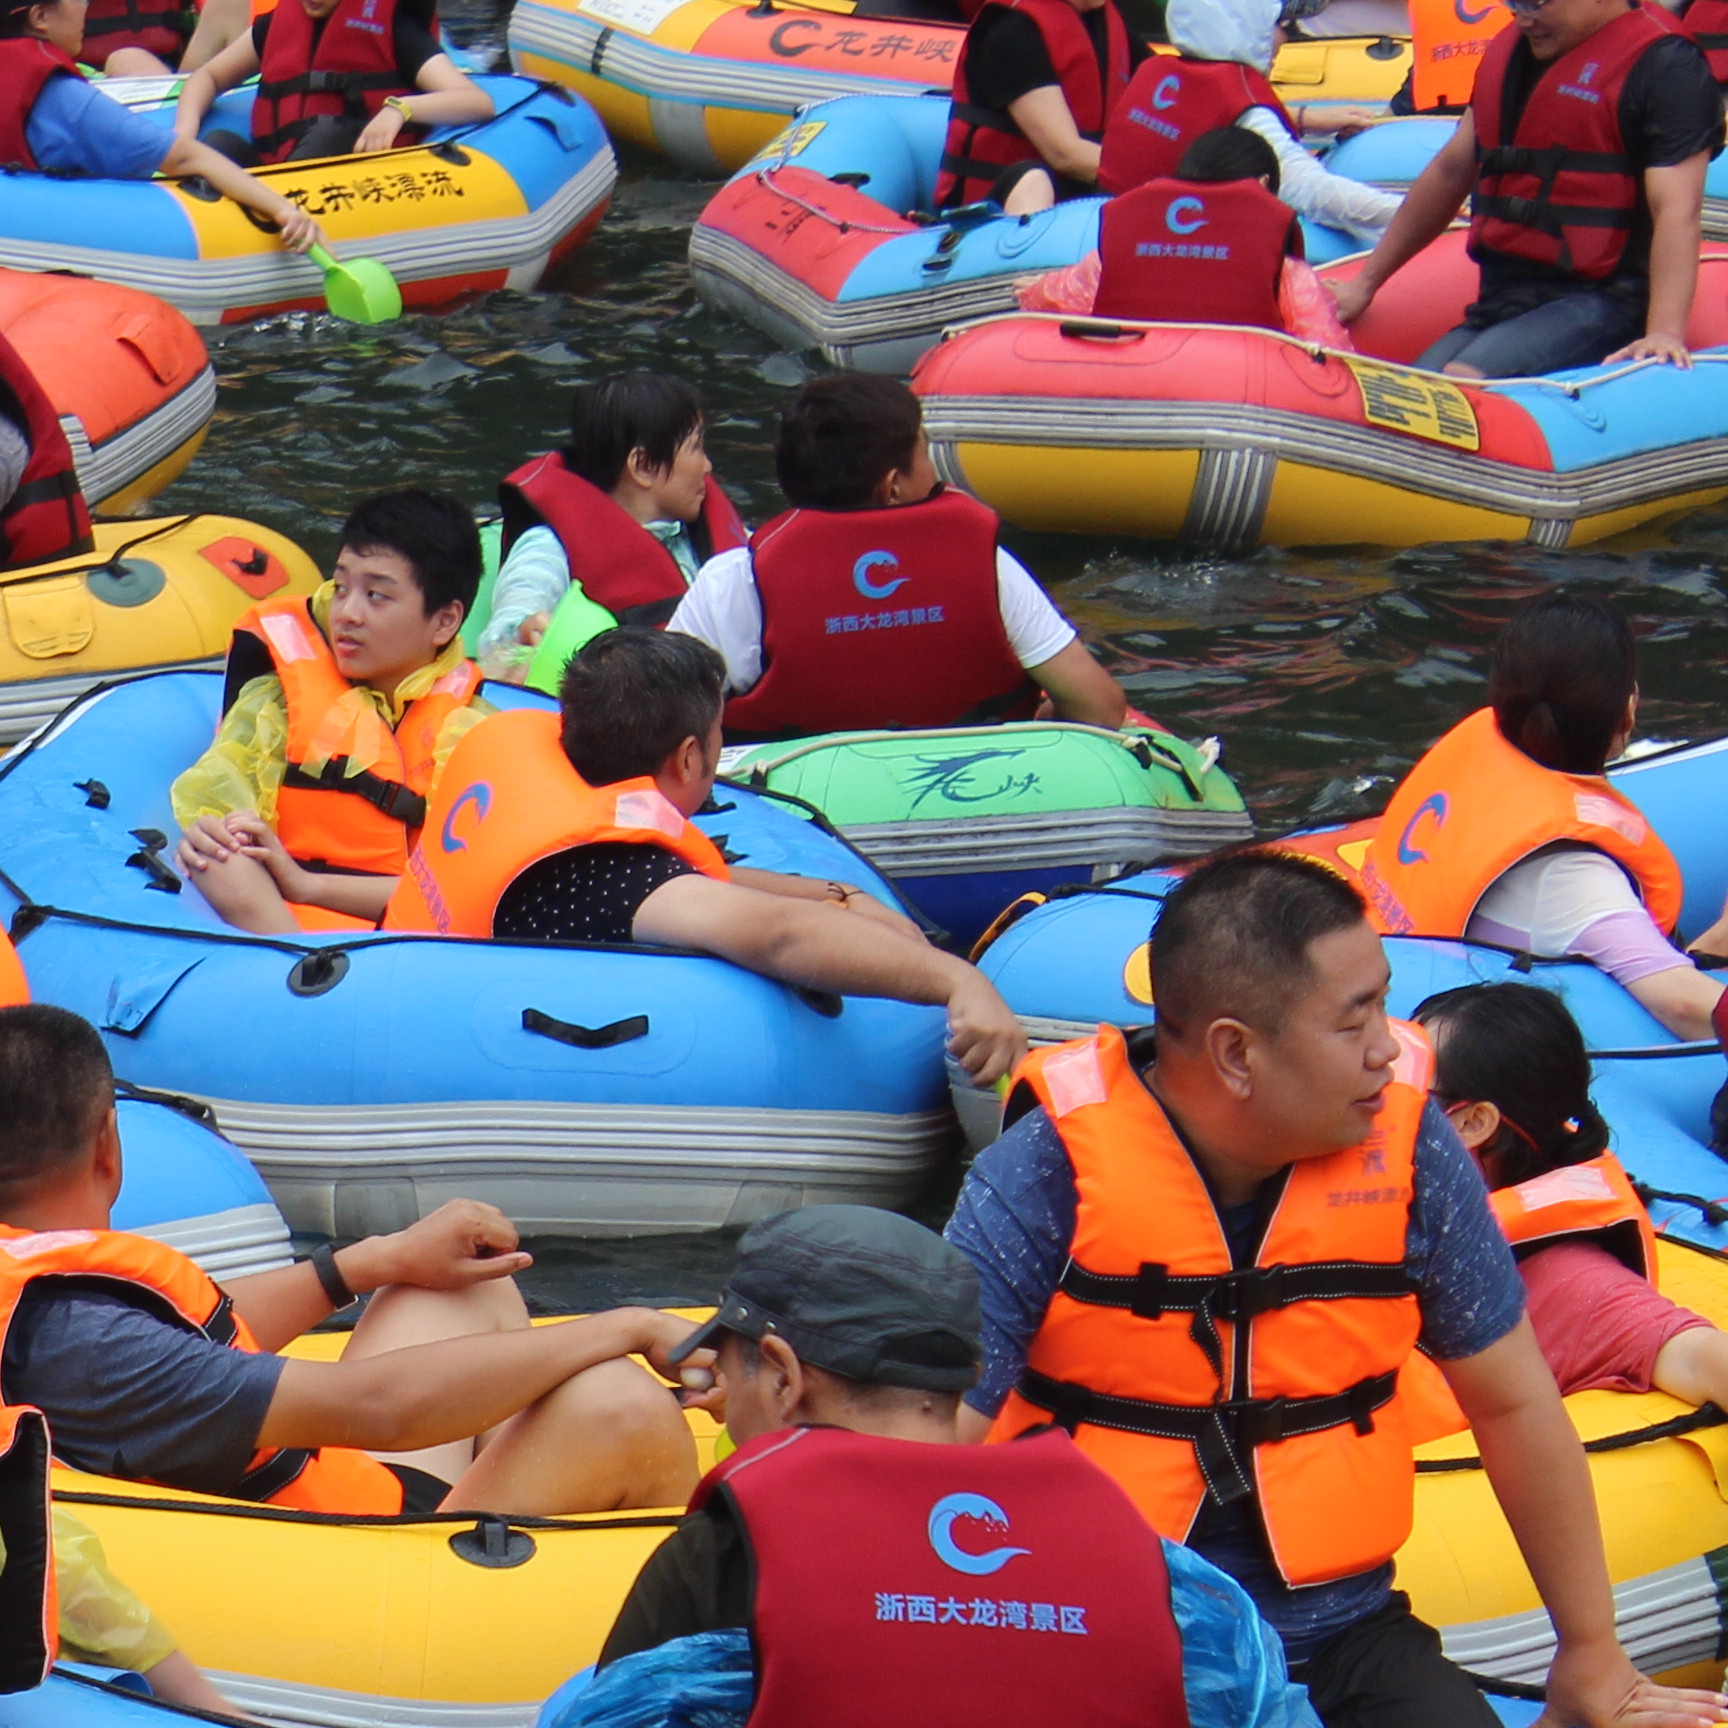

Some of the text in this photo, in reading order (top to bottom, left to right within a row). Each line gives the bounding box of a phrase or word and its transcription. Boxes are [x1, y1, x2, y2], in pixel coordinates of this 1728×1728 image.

[825, 605, 944, 635] 浙西大龙湾景区
[875, 1591, 1088, 1636] 浙西大龙湾景区
